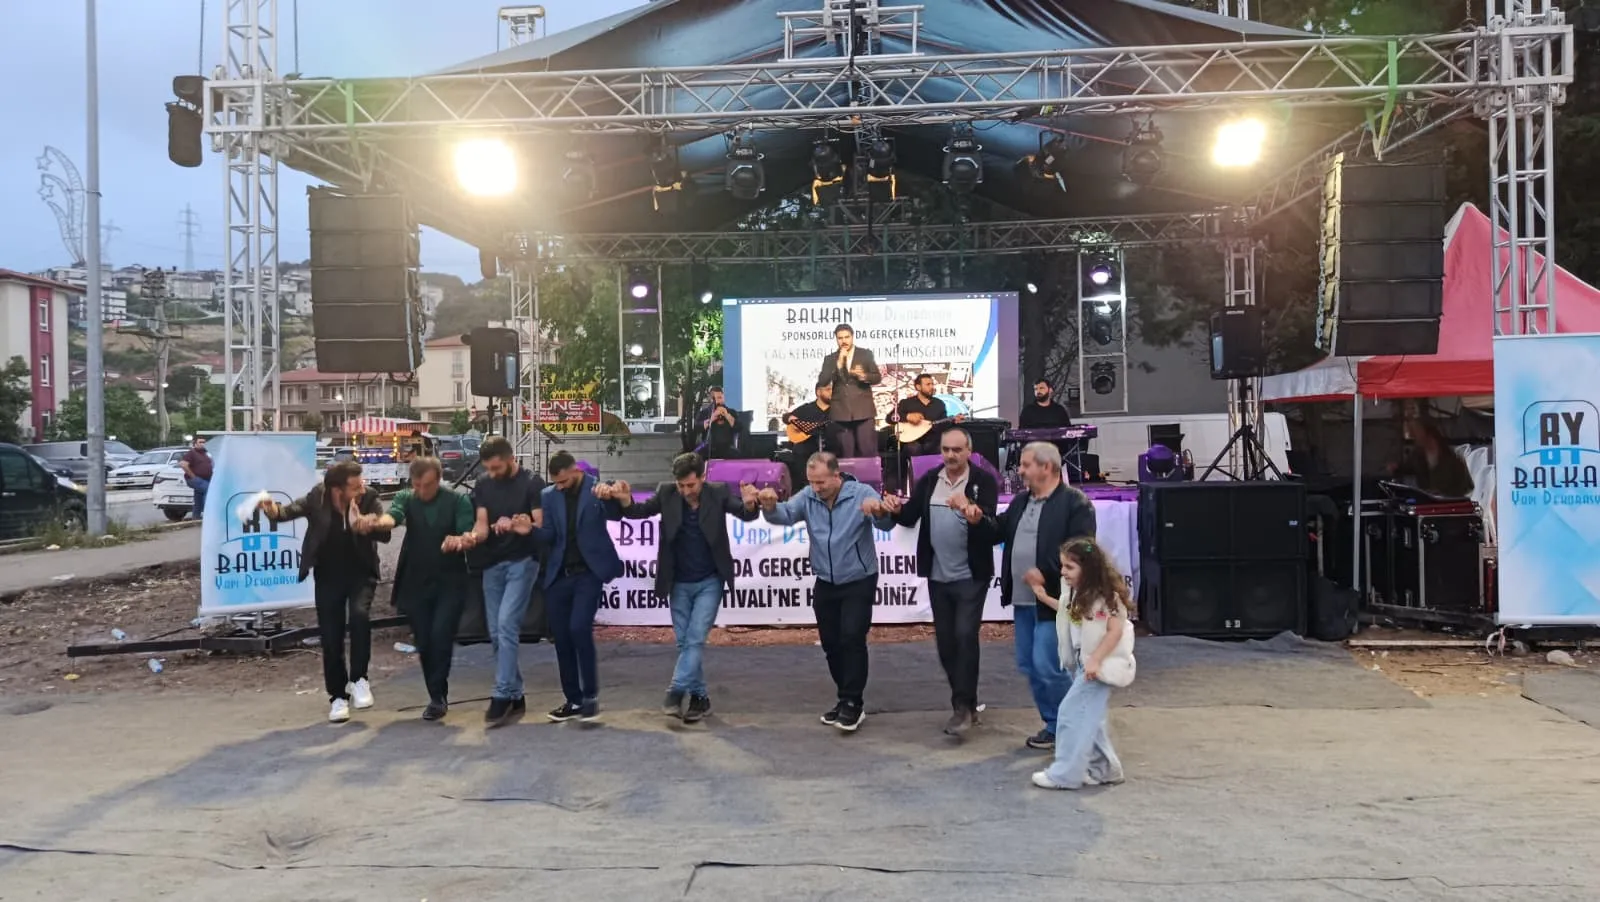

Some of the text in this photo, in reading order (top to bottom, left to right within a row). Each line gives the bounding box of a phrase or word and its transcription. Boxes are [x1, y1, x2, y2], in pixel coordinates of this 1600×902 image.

[785, 307, 853, 324] BALKAN
[526, 400, 593, 411] ONEX
[571, 423, 584, 432] 70
[587, 423, 600, 432] 60
[1510, 465, 1600, 489] BALKA
[598, 586, 620, 609] AĞ
[626, 589, 669, 609] KEBA
